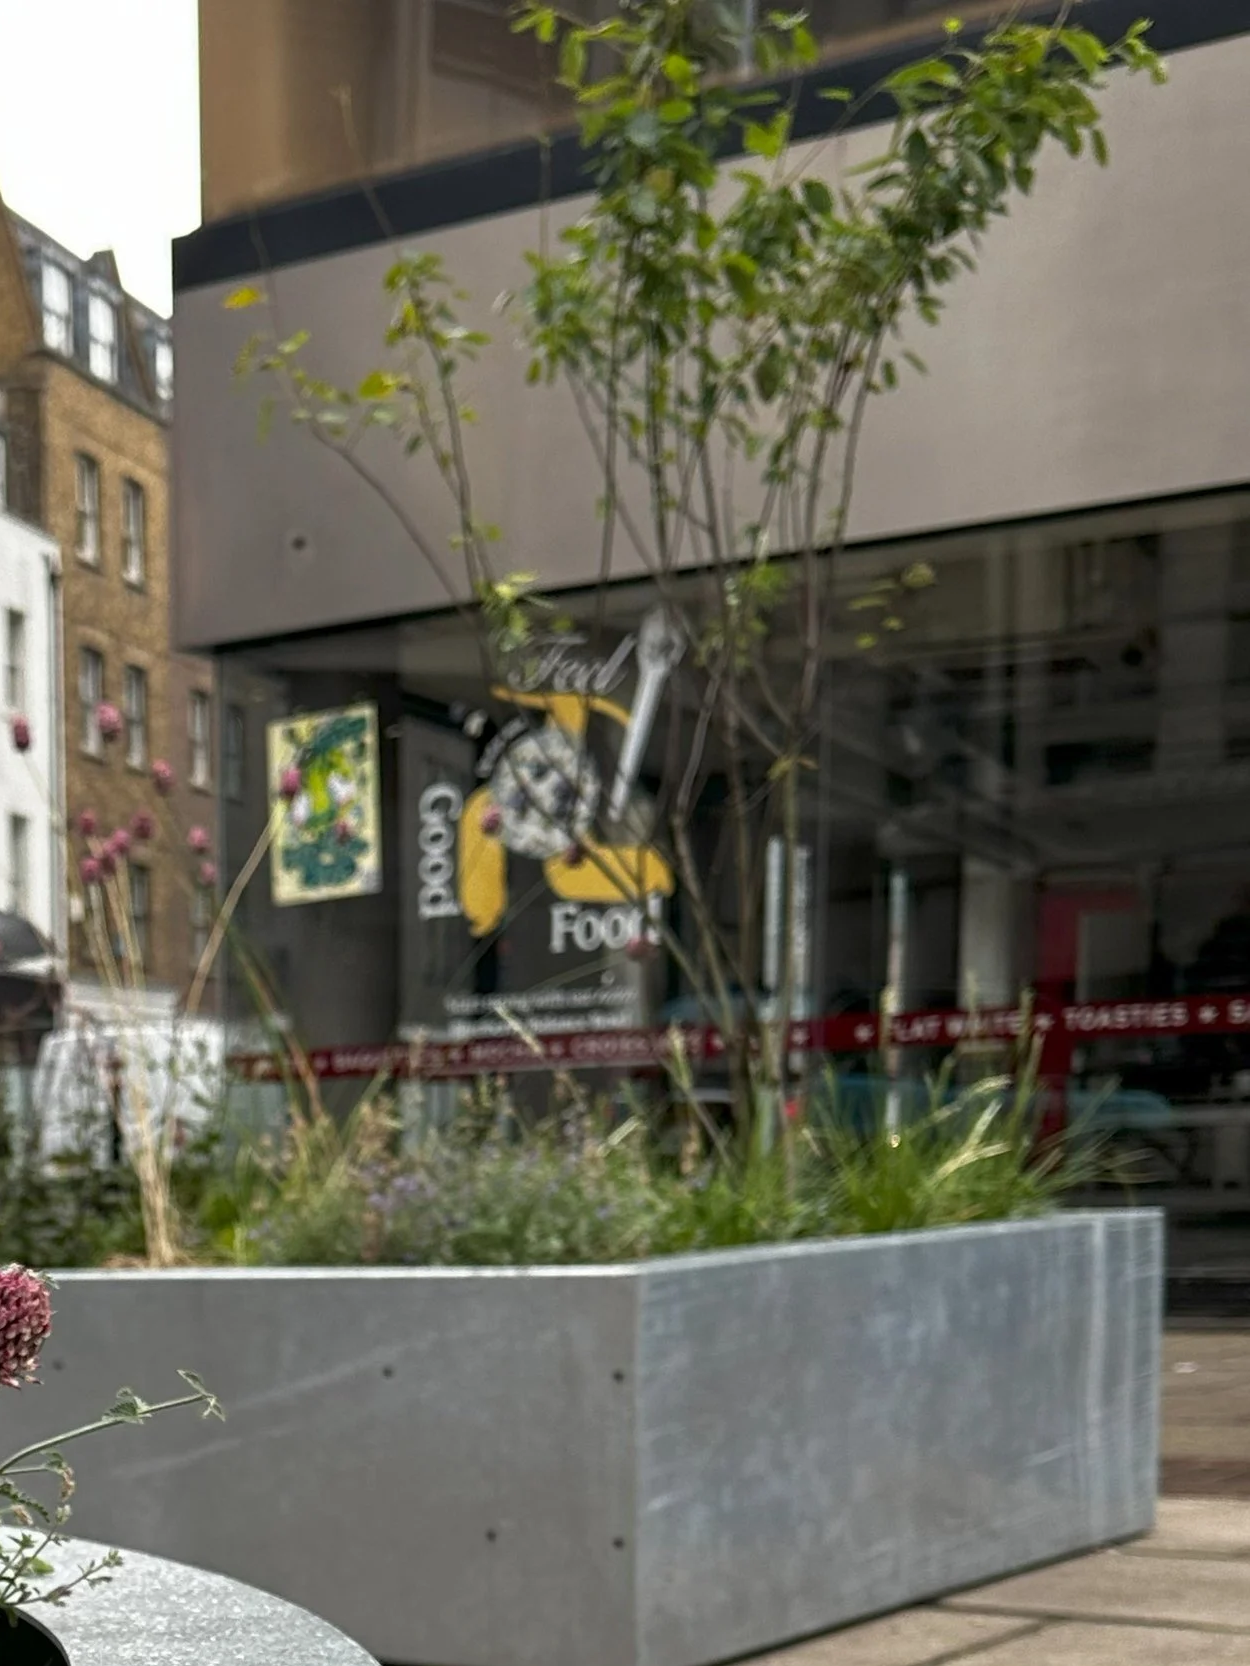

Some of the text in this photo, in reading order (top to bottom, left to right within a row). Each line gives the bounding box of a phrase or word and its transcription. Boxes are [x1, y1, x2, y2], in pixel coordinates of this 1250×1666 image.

[417, 782, 463, 921] Good
[550, 893, 662, 955] Food
[1063, 1001, 1189, 1031] TOASTIES
